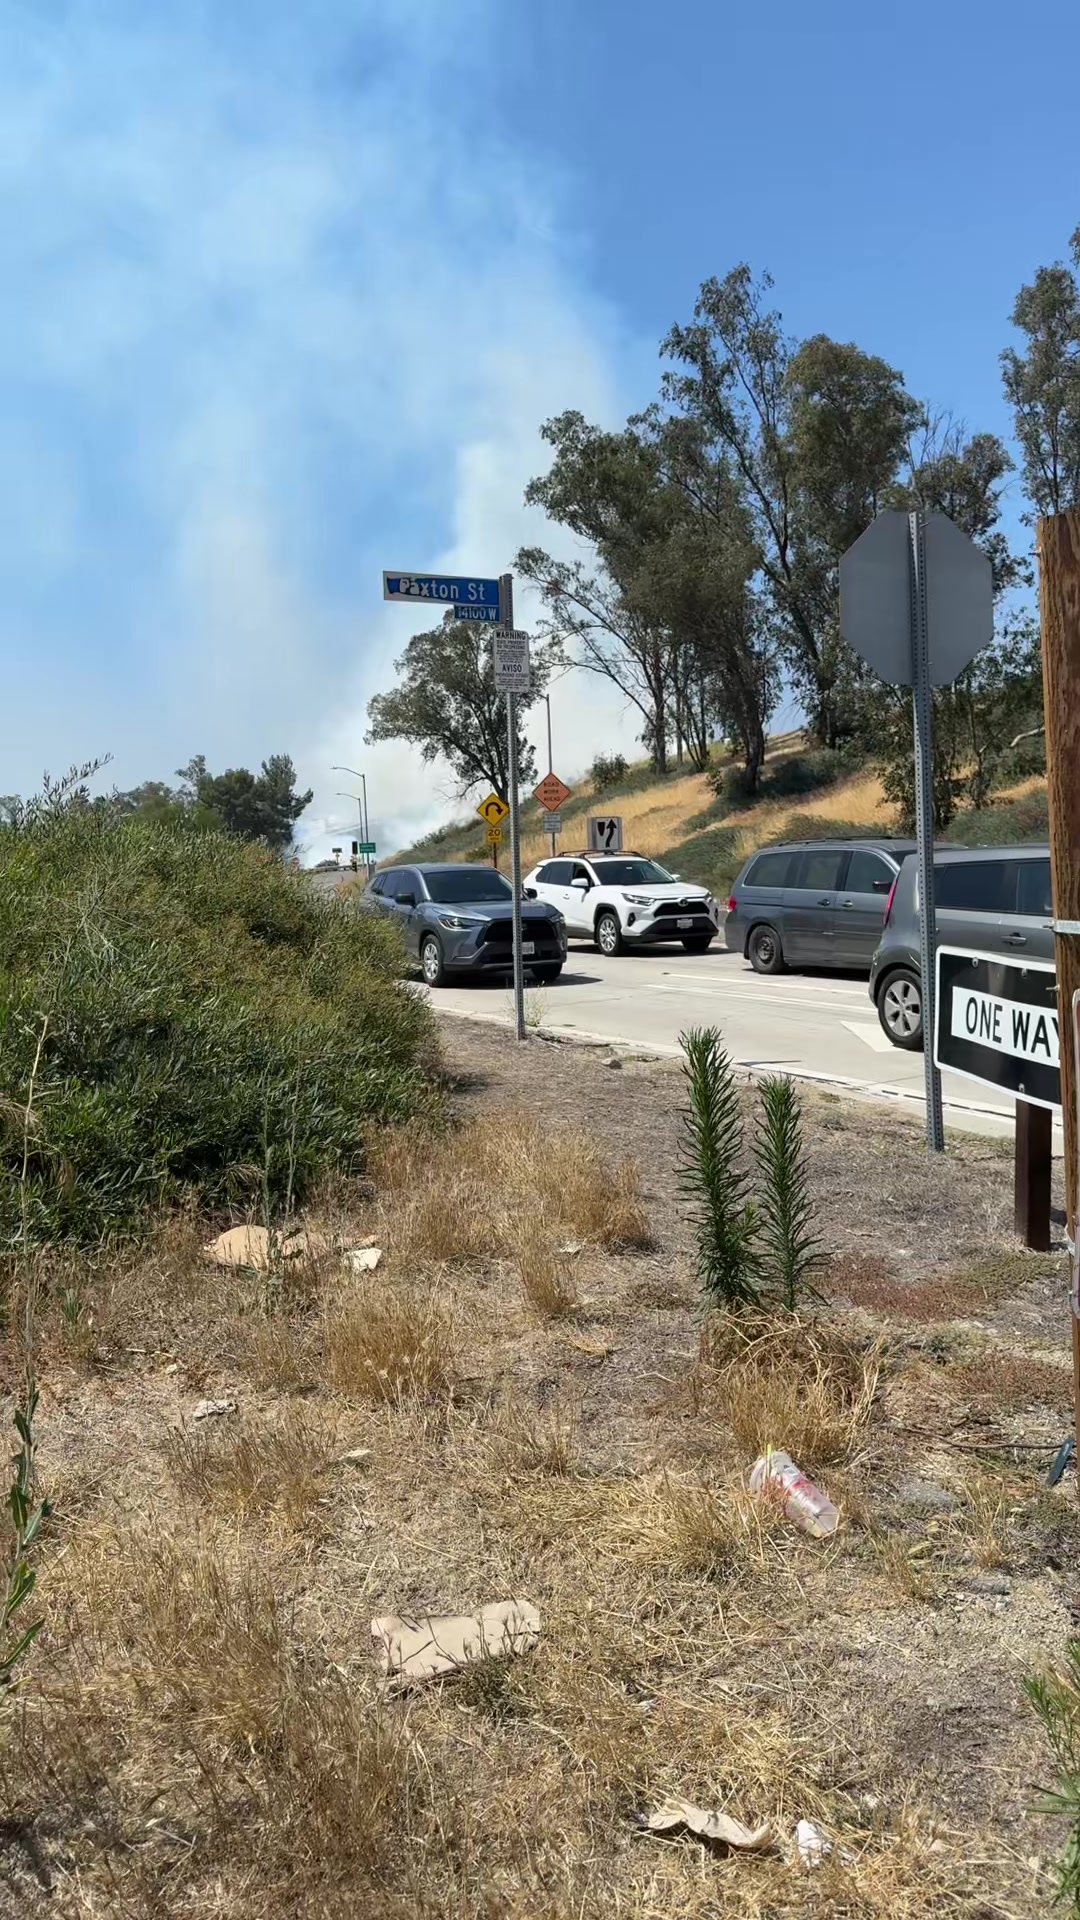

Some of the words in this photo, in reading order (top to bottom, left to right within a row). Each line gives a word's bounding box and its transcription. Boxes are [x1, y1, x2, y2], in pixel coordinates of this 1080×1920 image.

[399, 578, 459, 599] Paxton
[468, 582, 486, 601] St
[458, 607, 486, 620] 14100
[488, 607, 497, 620] W
[496, 631, 526, 641] WARNING
[502, 664, 523, 673] AVISO
[488, 829, 501, 837] 20
[965, 996, 1003, 1044] ONE
